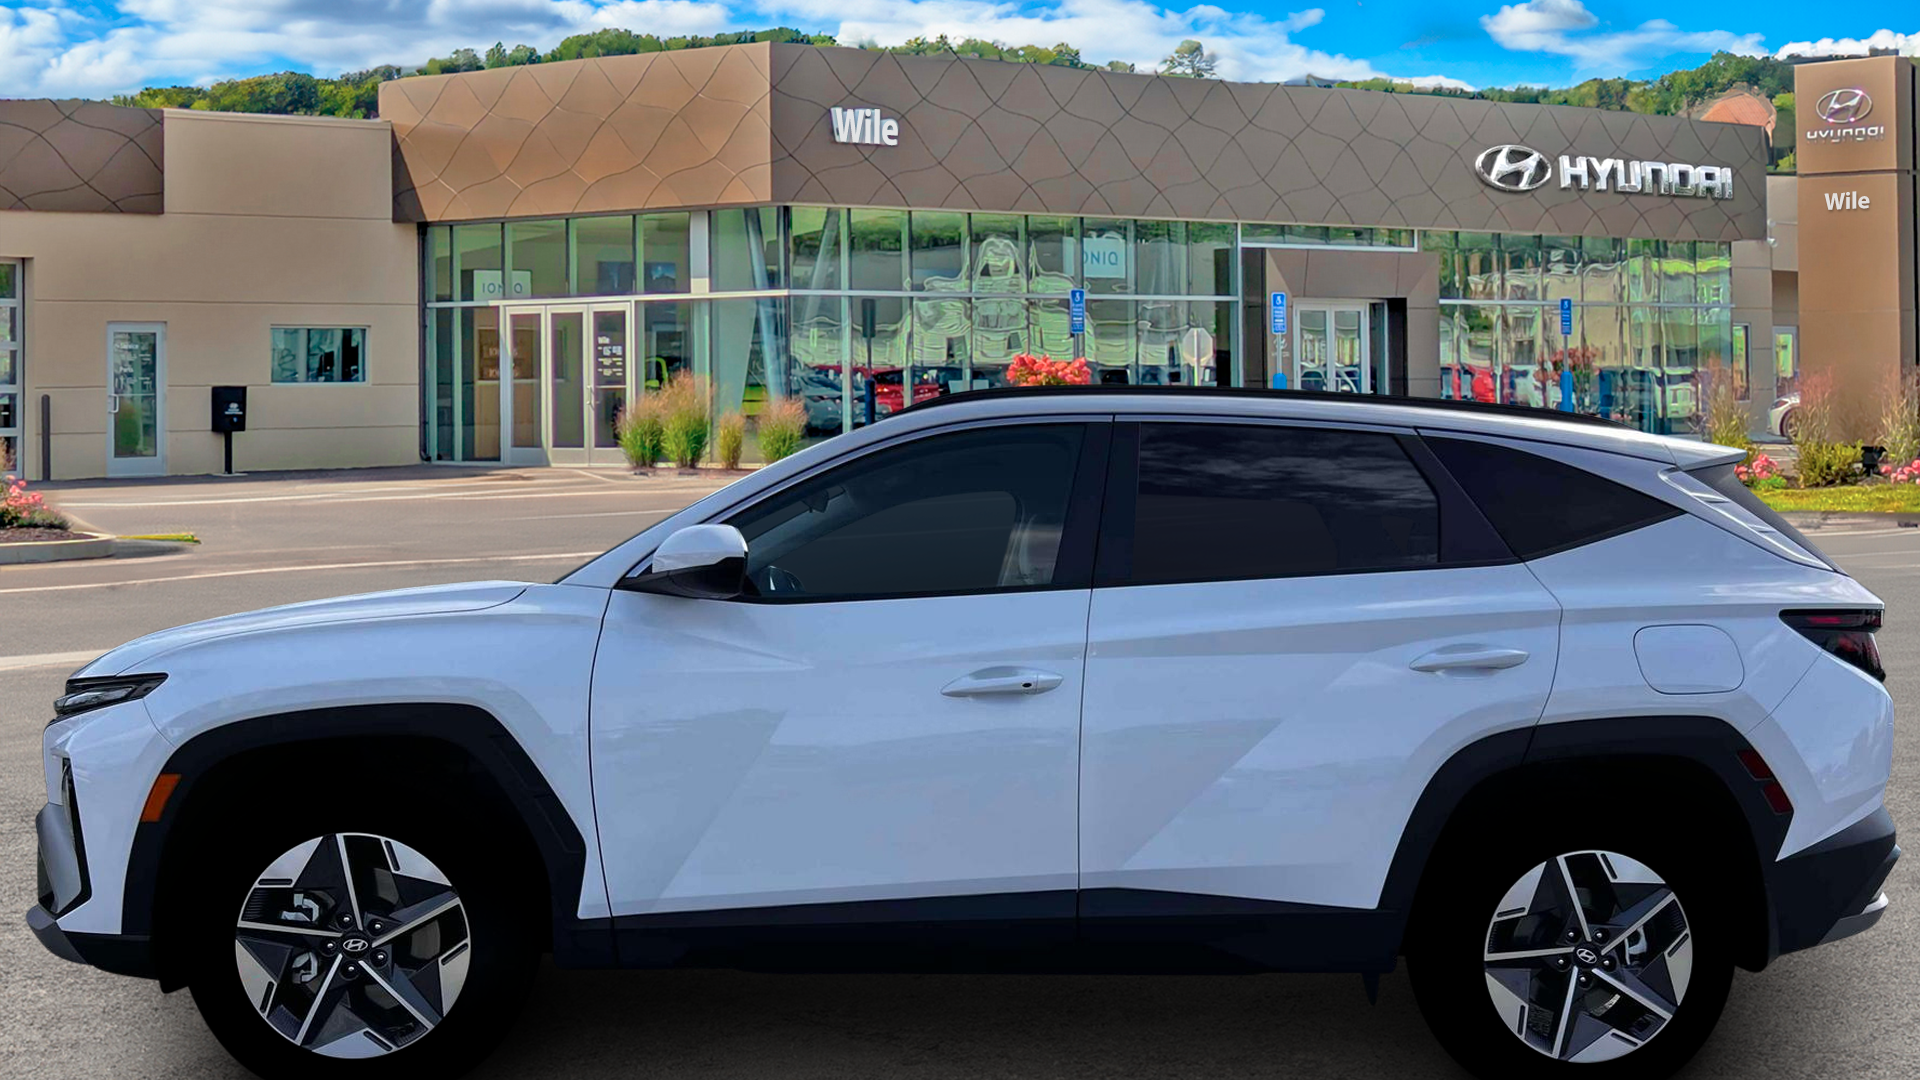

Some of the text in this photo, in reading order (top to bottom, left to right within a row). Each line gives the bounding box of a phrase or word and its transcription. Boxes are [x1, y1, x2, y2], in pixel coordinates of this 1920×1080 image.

[829, 107, 899, 146] Wile
[1558, 155, 1733, 200] HYUNDAI
[1824, 191, 1870, 210] Wile
